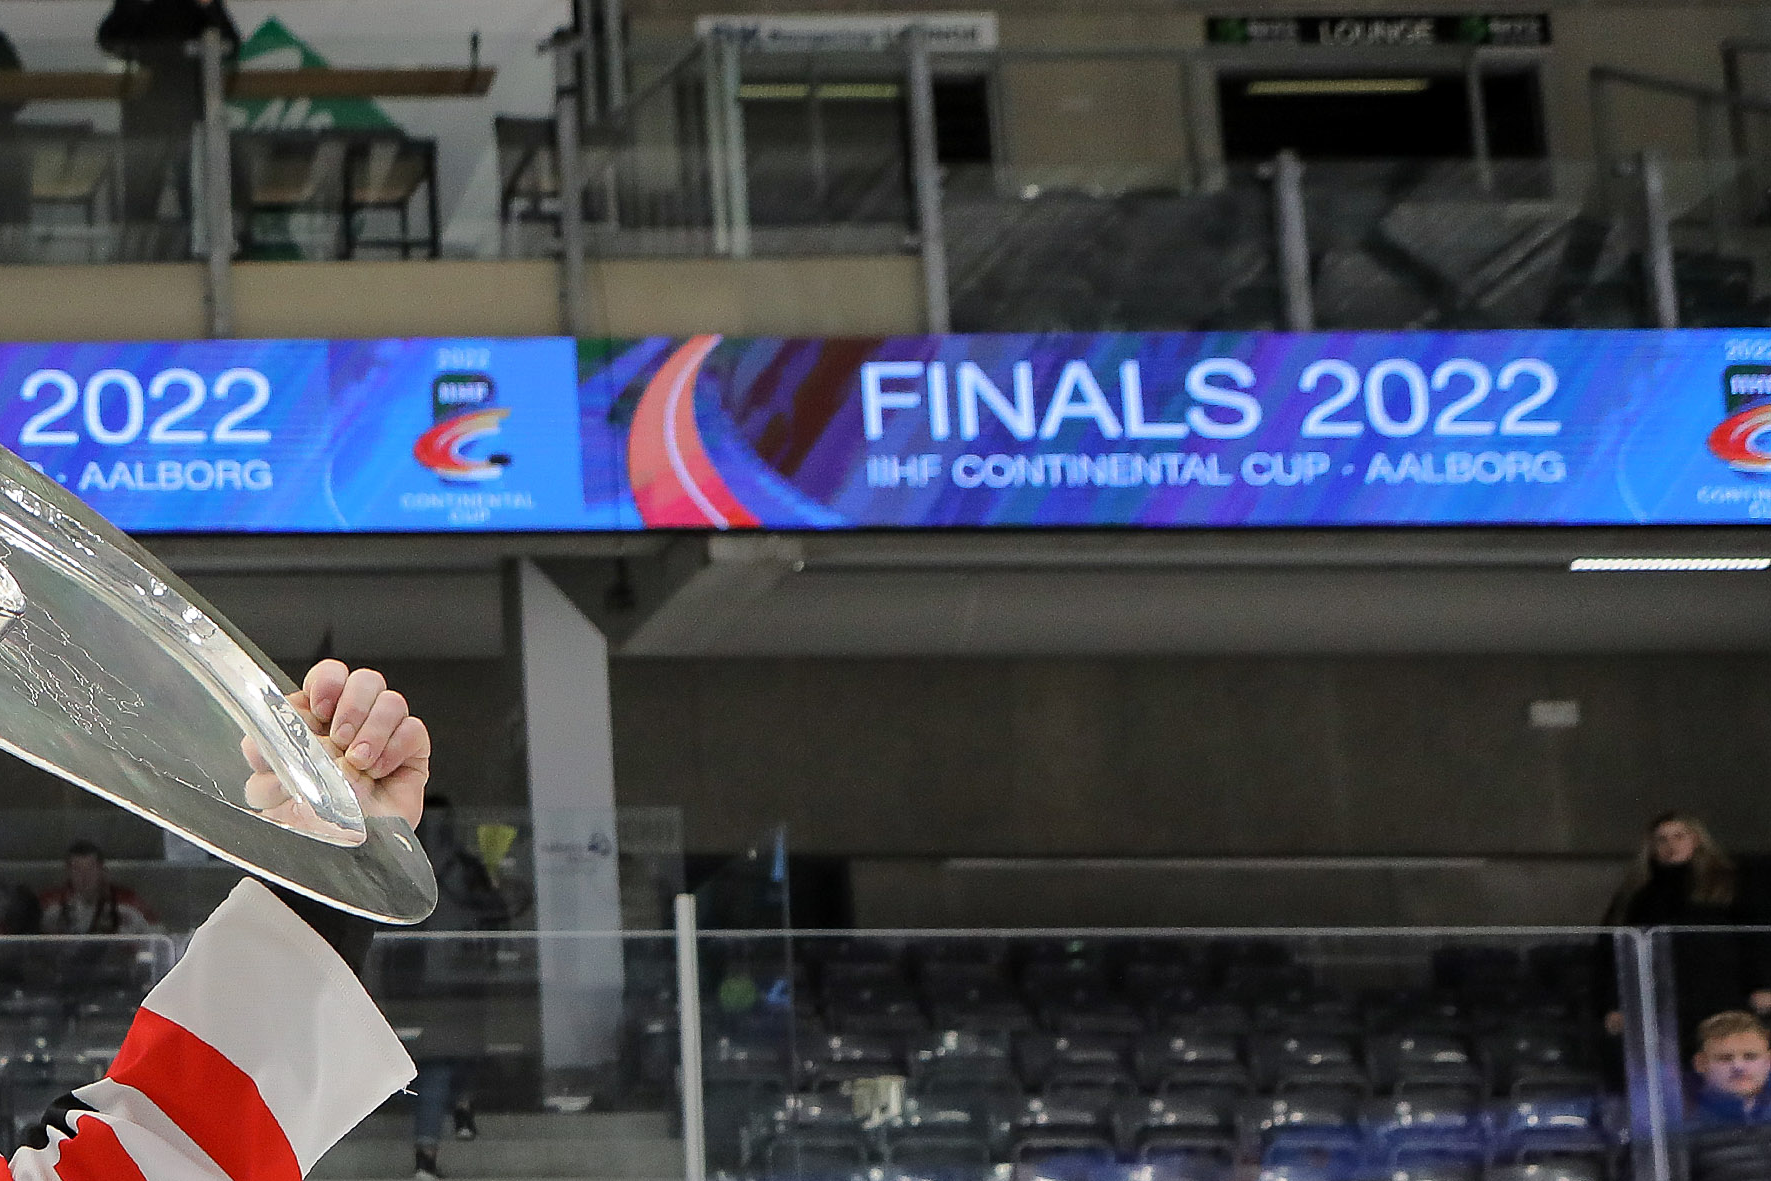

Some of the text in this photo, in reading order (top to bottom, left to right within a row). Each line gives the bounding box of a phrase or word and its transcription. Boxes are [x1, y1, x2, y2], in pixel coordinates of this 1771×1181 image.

[18, 367, 272, 446] 2022
[860, 357, 1562, 442] FINALS 2022
[78, 460, 274, 493] AALBORG
[866, 450, 1567, 489] IIHF CONTINENTAL CUP AALBORG
